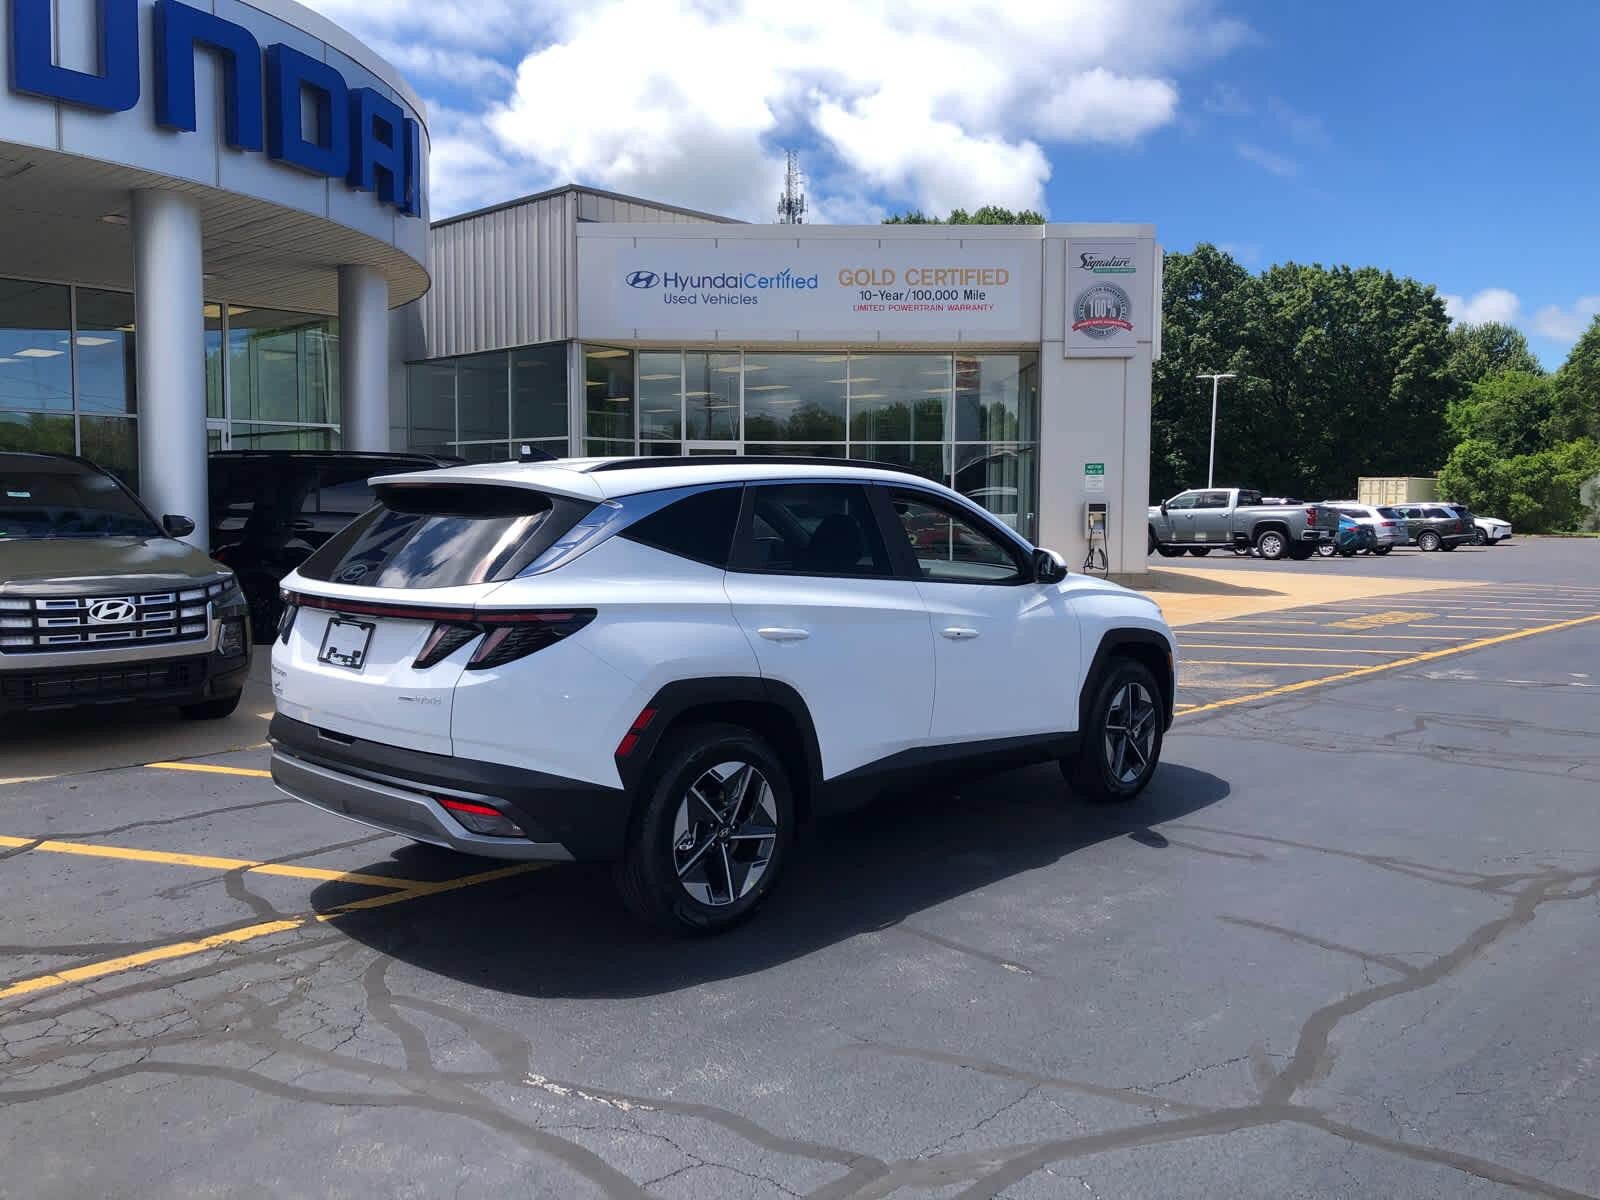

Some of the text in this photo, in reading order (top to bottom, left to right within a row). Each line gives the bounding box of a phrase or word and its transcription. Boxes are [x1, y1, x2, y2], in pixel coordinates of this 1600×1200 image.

[1080, 252, 1130, 271] Signature
[838, 268, 1010, 287] GOLD CERTIFIED
[664, 293, 758, 305] Used Vehicles
[859, 289, 986, 302] 10-Year/100,000 Mile
[853, 304, 994, 312] LIMITED POWERTRAIN WARRANTY
[1088, 299, 1117, 318] 100%
